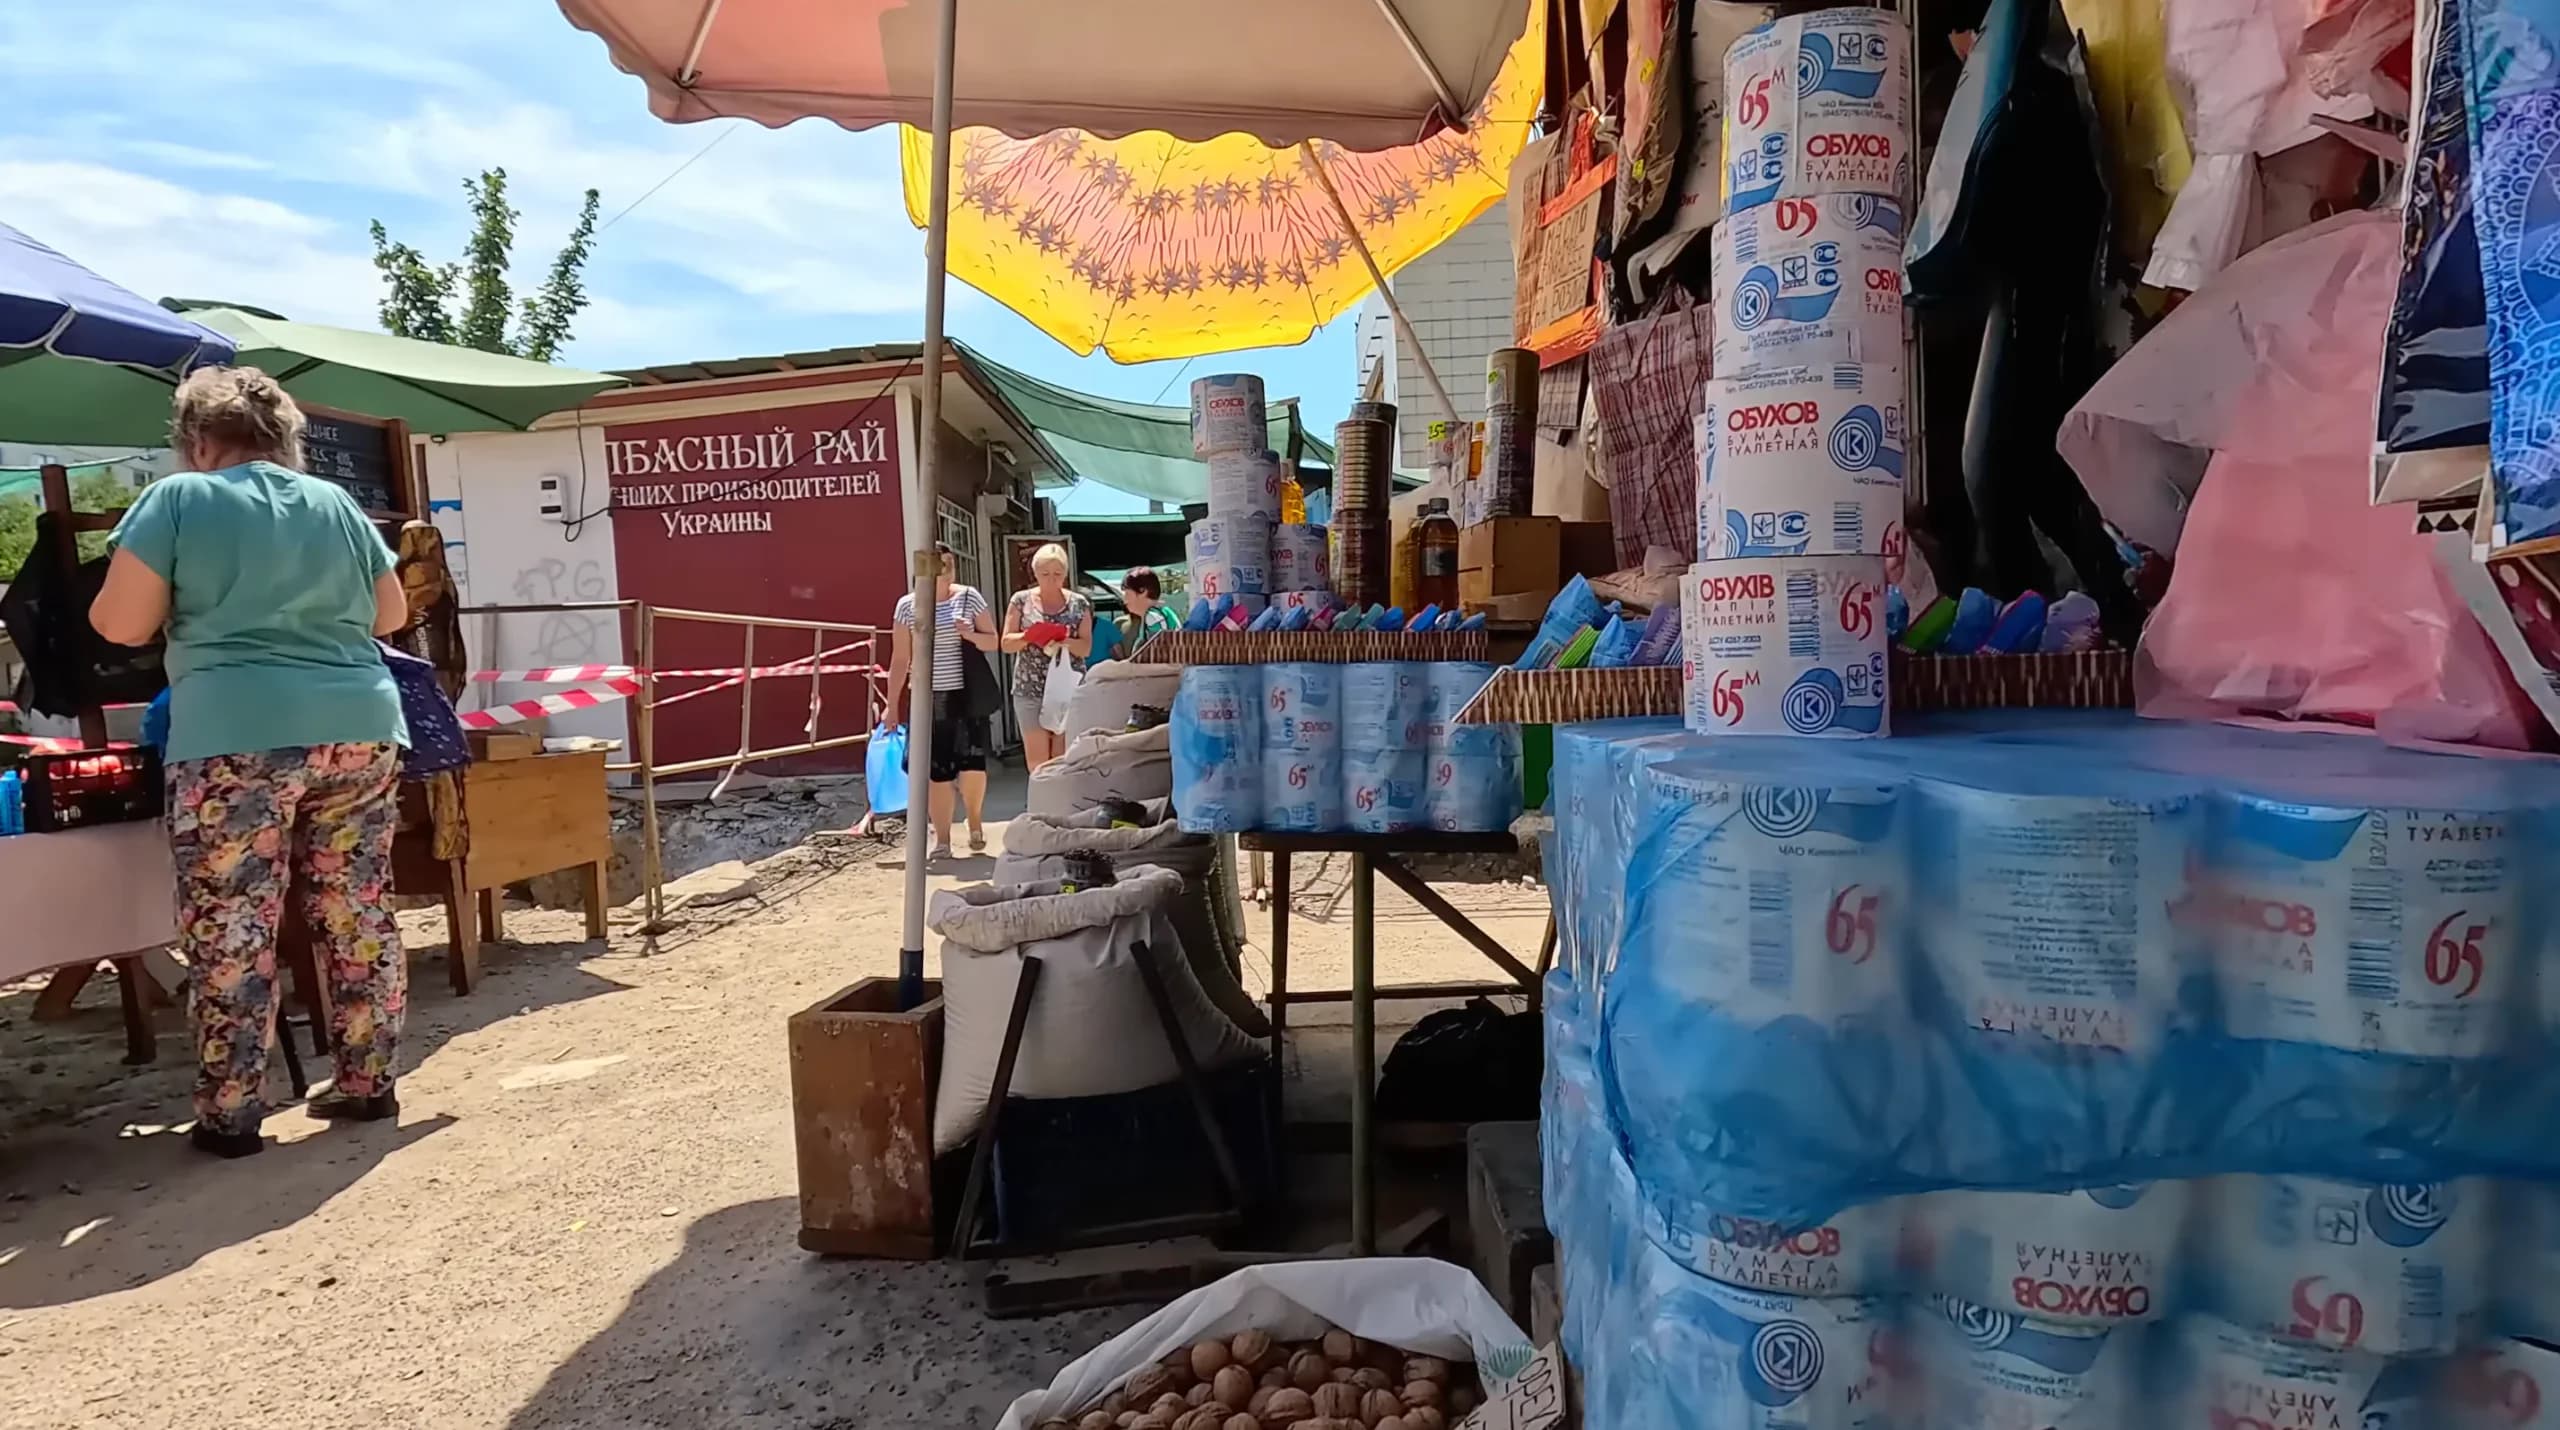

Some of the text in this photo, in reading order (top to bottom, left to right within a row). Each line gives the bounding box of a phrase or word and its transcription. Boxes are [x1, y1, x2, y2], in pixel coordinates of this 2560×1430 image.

[1806, 133, 1890, 158] ОБУХОВ
[1806, 159, 1889, 171] БУМАГА
[1806, 170, 1889, 183] ТУАЛЕТНАЯ
[1728, 401, 1819, 432] ОБУХОВ
[812, 420, 888, 466] РАЙ
[1728, 427, 1817, 446] БУМАГА
[1728, 438, 1819, 457] ТУАЛЕТНАЯ
[682, 470, 882, 504] ПРОИЗВОДИТЕЛЕЙ
[662, 509, 772, 539] УКРАИНЫ
[1700, 574, 1775, 601] ОБУХІВ
[1701, 600, 1774, 613] ПАПІР
[1702, 611, 1775, 627] ТУАЛЕТНИЙ
[1826, 884, 1878, 965] 65
[1709, 1242, 1839, 1273] БУМАГА
[2017, 1242, 2146, 1266] УАЛЕТНАЯ
[1709, 1259, 1839, 1289] ТУАЛЕТНАЯ
[2019, 1259, 2140, 1283] УМАГА
[2012, 1277, 2149, 1316] ОБУХОВ
